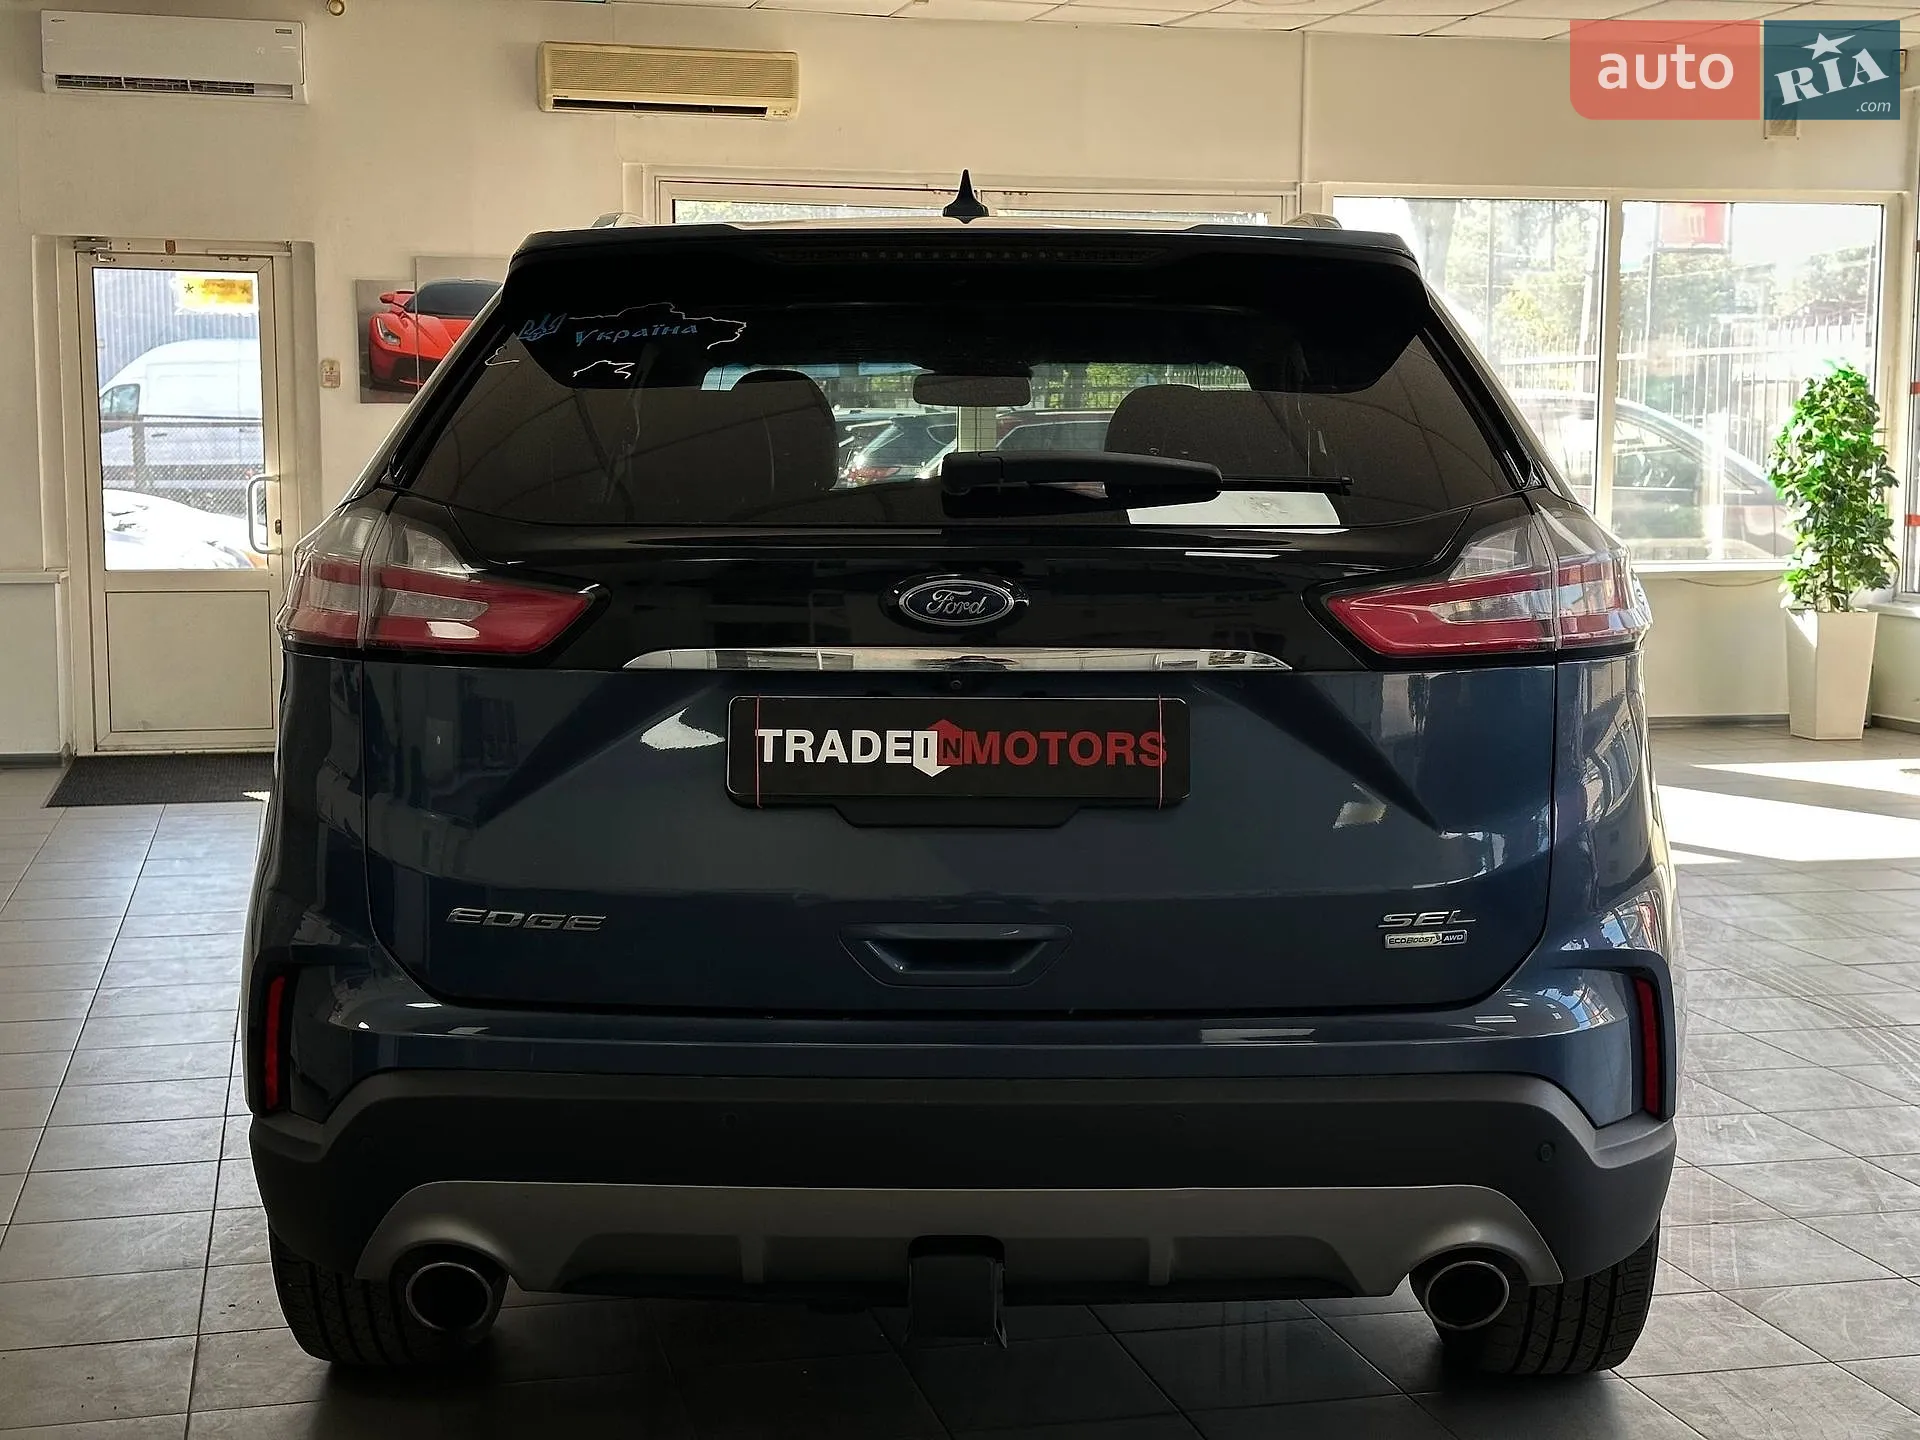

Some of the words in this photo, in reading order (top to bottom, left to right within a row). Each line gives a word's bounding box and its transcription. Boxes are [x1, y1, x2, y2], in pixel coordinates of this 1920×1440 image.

[575, 323, 699, 347] Україна
[926, 589, 987, 615] Ford
[963, 730, 1168, 767] MOTORS
[446, 907, 607, 932] EDGE
[1377, 909, 1477, 928] SEL
[1388, 935, 1436, 945] ECOBOOST
[1443, 933, 1464, 943] AWD
